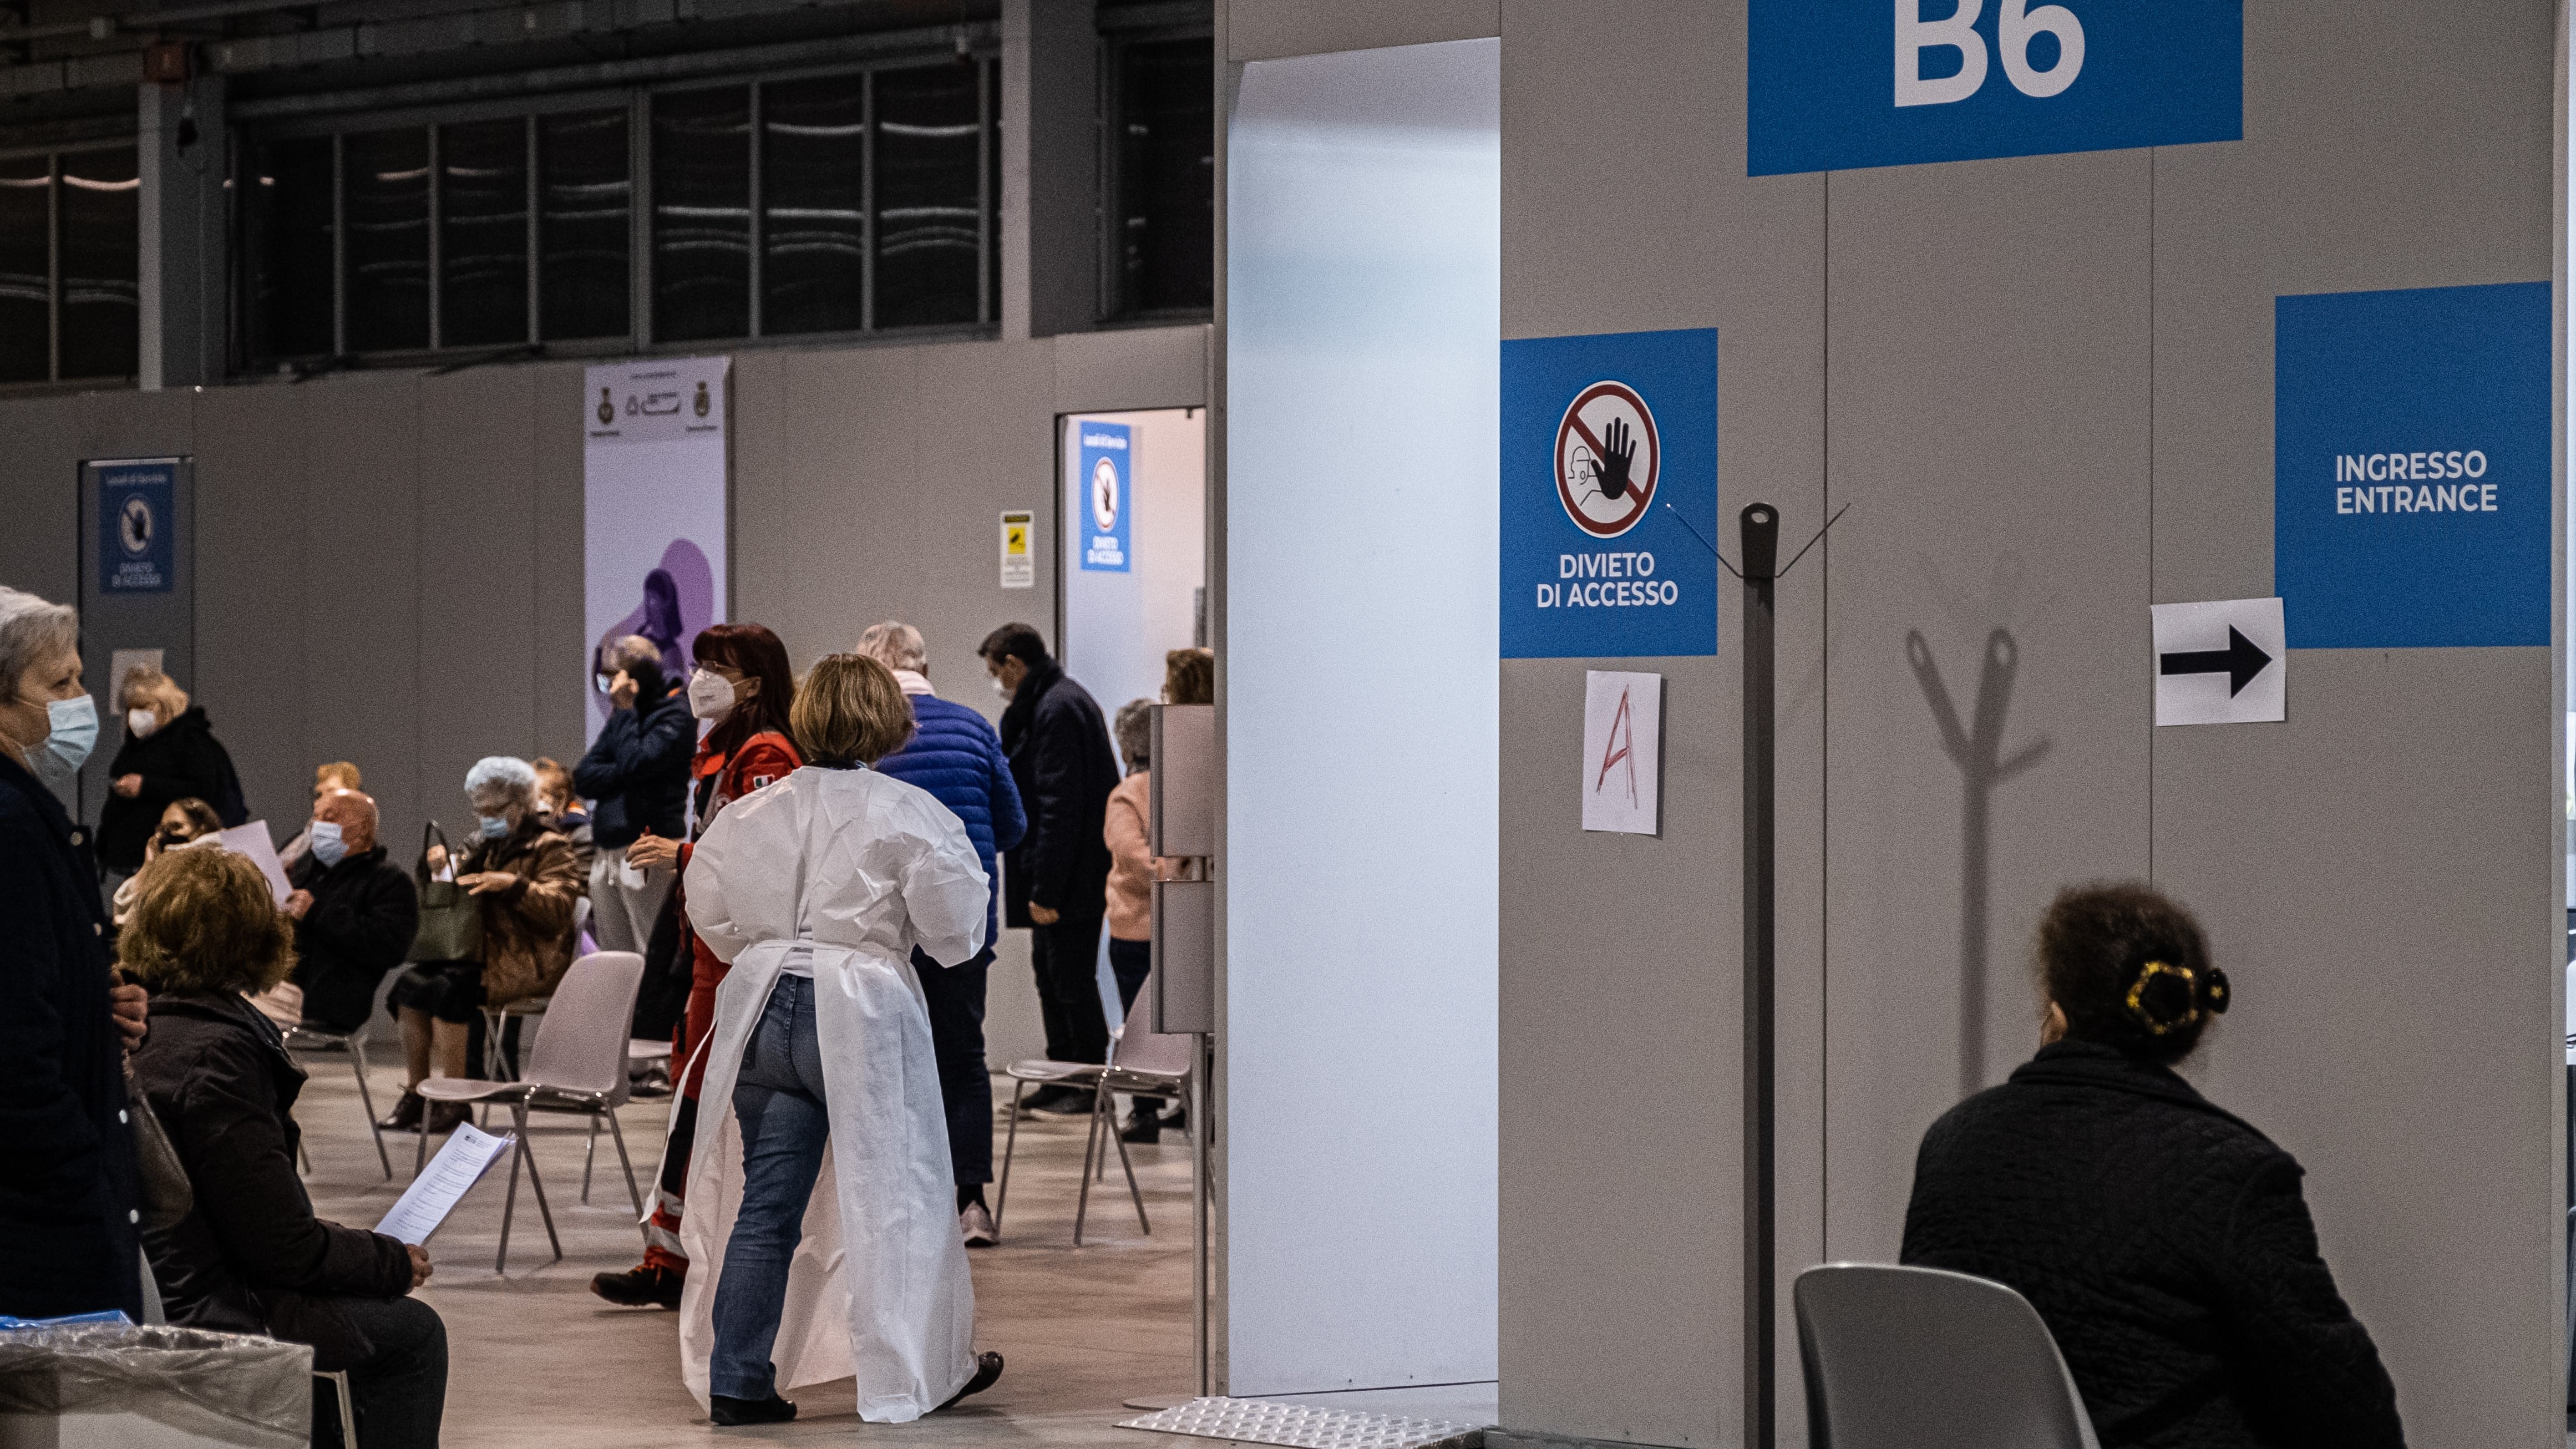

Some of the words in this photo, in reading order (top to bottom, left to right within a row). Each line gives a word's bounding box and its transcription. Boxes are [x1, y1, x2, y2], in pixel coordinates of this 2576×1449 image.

[1894, 0, 2086, 107] B6
[2336, 450, 2487, 482] INGRESSO
[2336, 484, 2498, 514] ENTRANCE
[1560, 551, 1655, 579] DIVIETO
[1537, 583, 1560, 608] DI
[1567, 580, 1679, 607] ACCESSO
[1596, 683, 1638, 809] A
